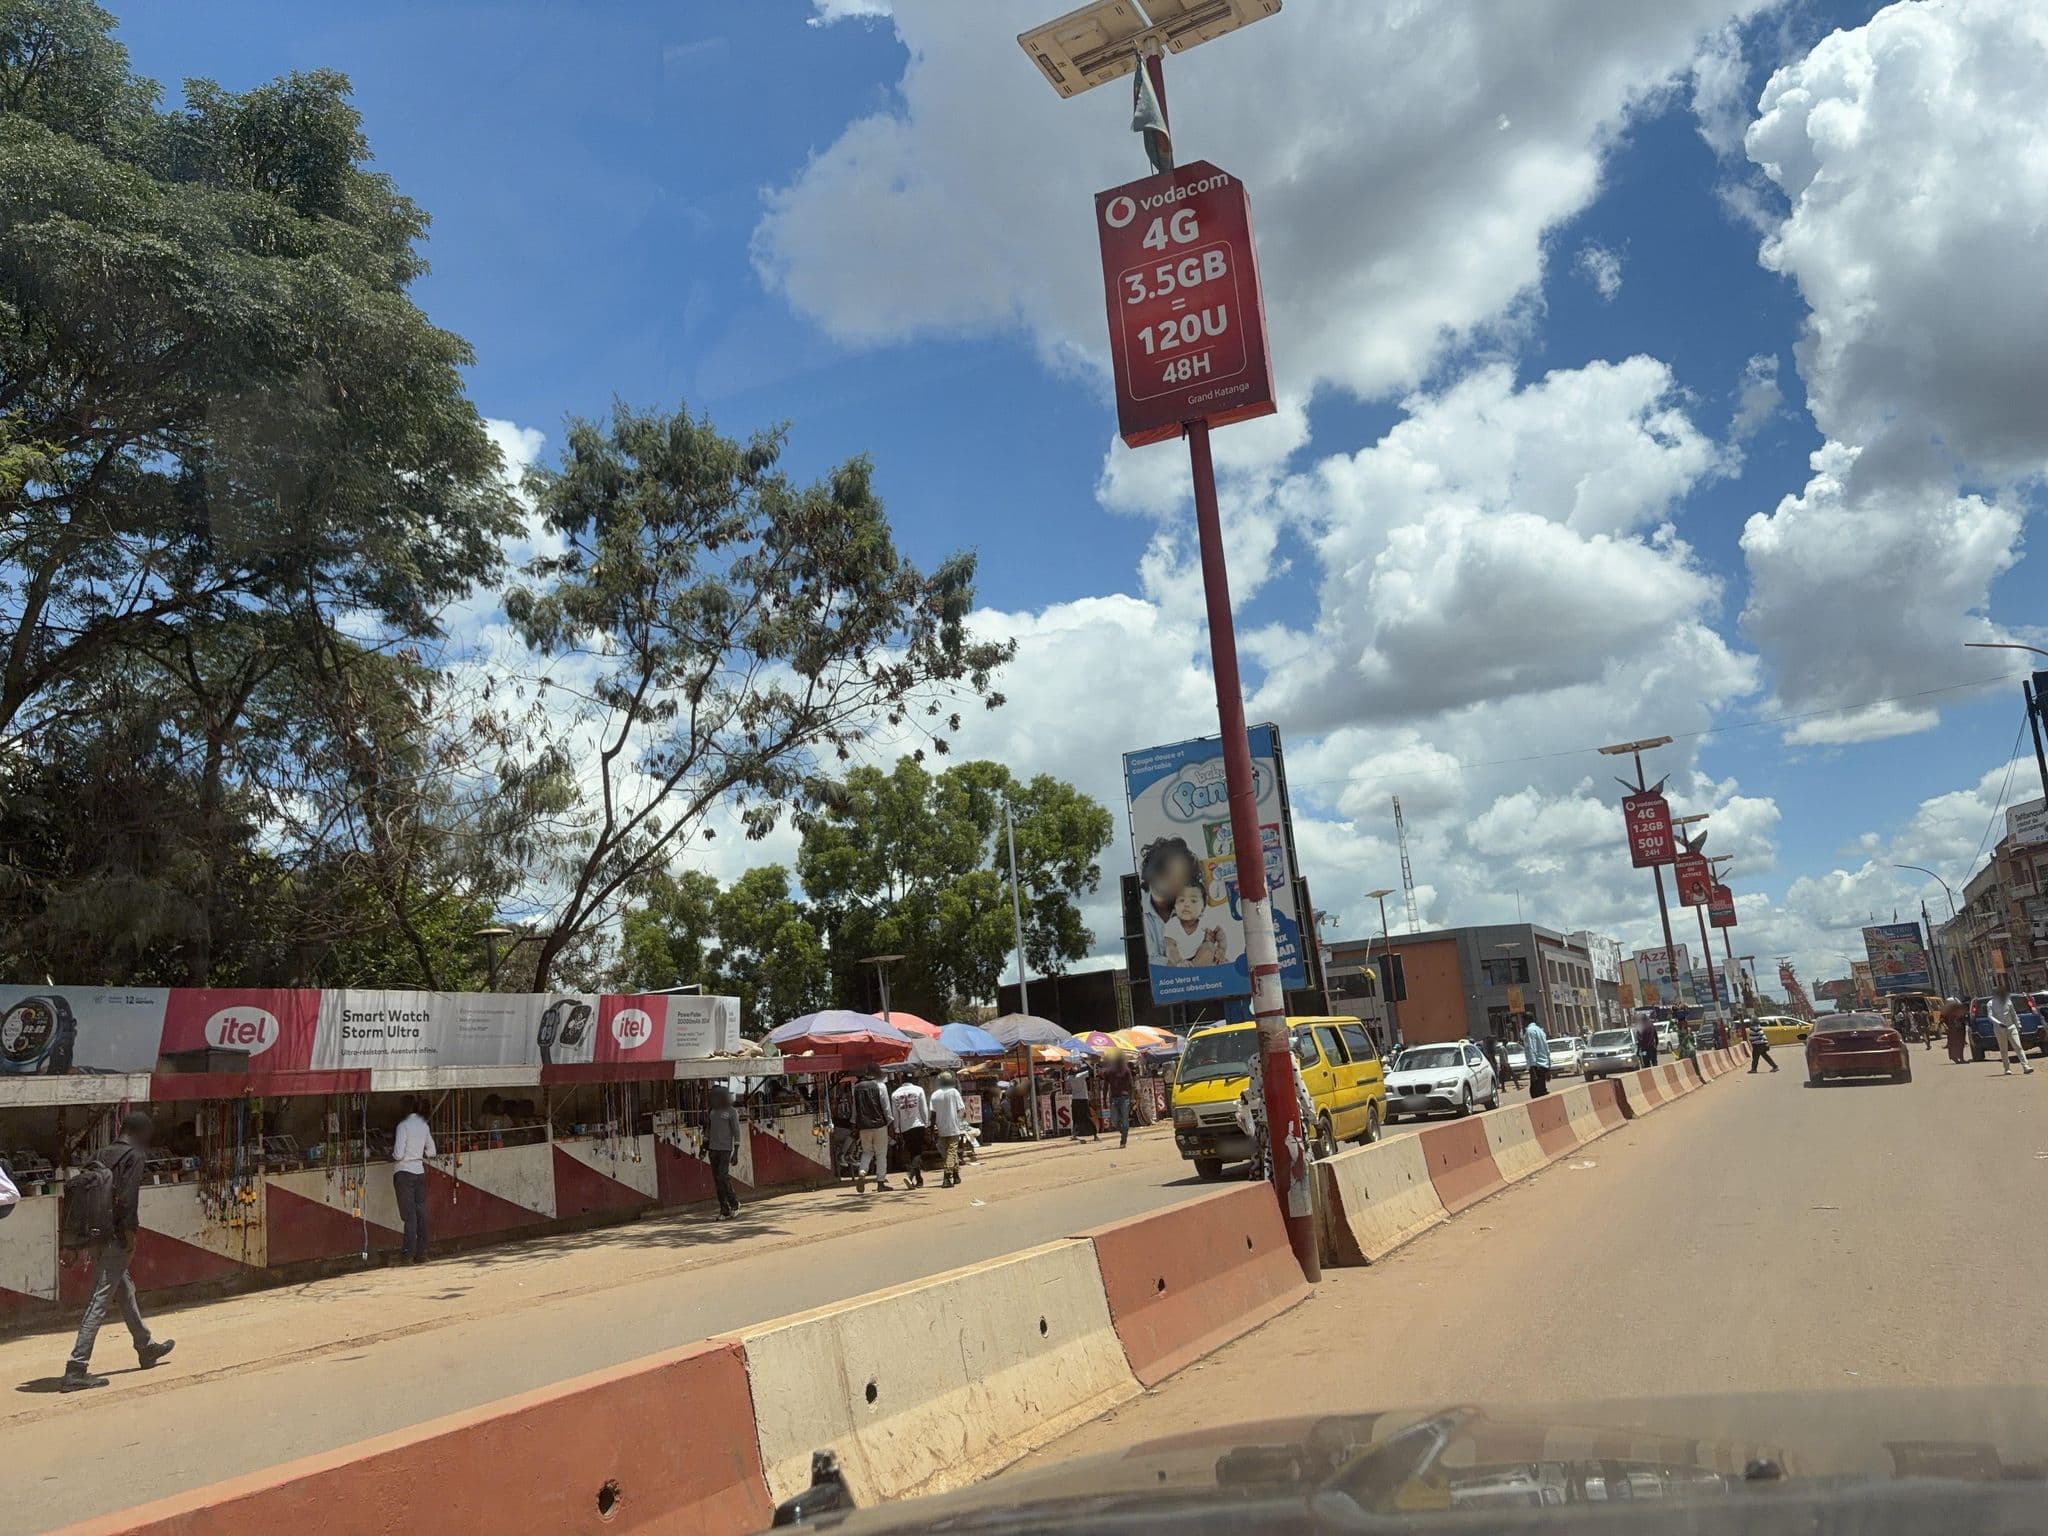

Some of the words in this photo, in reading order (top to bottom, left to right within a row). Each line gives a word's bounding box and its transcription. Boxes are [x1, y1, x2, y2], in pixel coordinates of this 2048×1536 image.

[1140, 173, 1229, 211] vodacom
[1142, 208, 1200, 251] 4G
[1125, 250, 1228, 305] 3.5GB
[1137, 304, 1228, 356] 120U
[1162, 352, 1211, 384] 48H
[1187, 391, 1213, 405] Grand
[1214, 382, 1250, 397] Katanga
[1637, 807, 1655, 819] 4G
[1632, 821, 1664, 833] 1.2GB
[1638, 836, 1664, 849] 50U
[1644, 848, 1660, 857] 24H
[342, 1009, 385, 1023] Smart
[388, 1009, 430, 1023] Watch
[619, 1016, 645, 1038] itel
[219, 1017, 266, 1046] itel
[341, 1025, 384, 1039] Storm
[387, 1024, 420, 1038] Ultra
